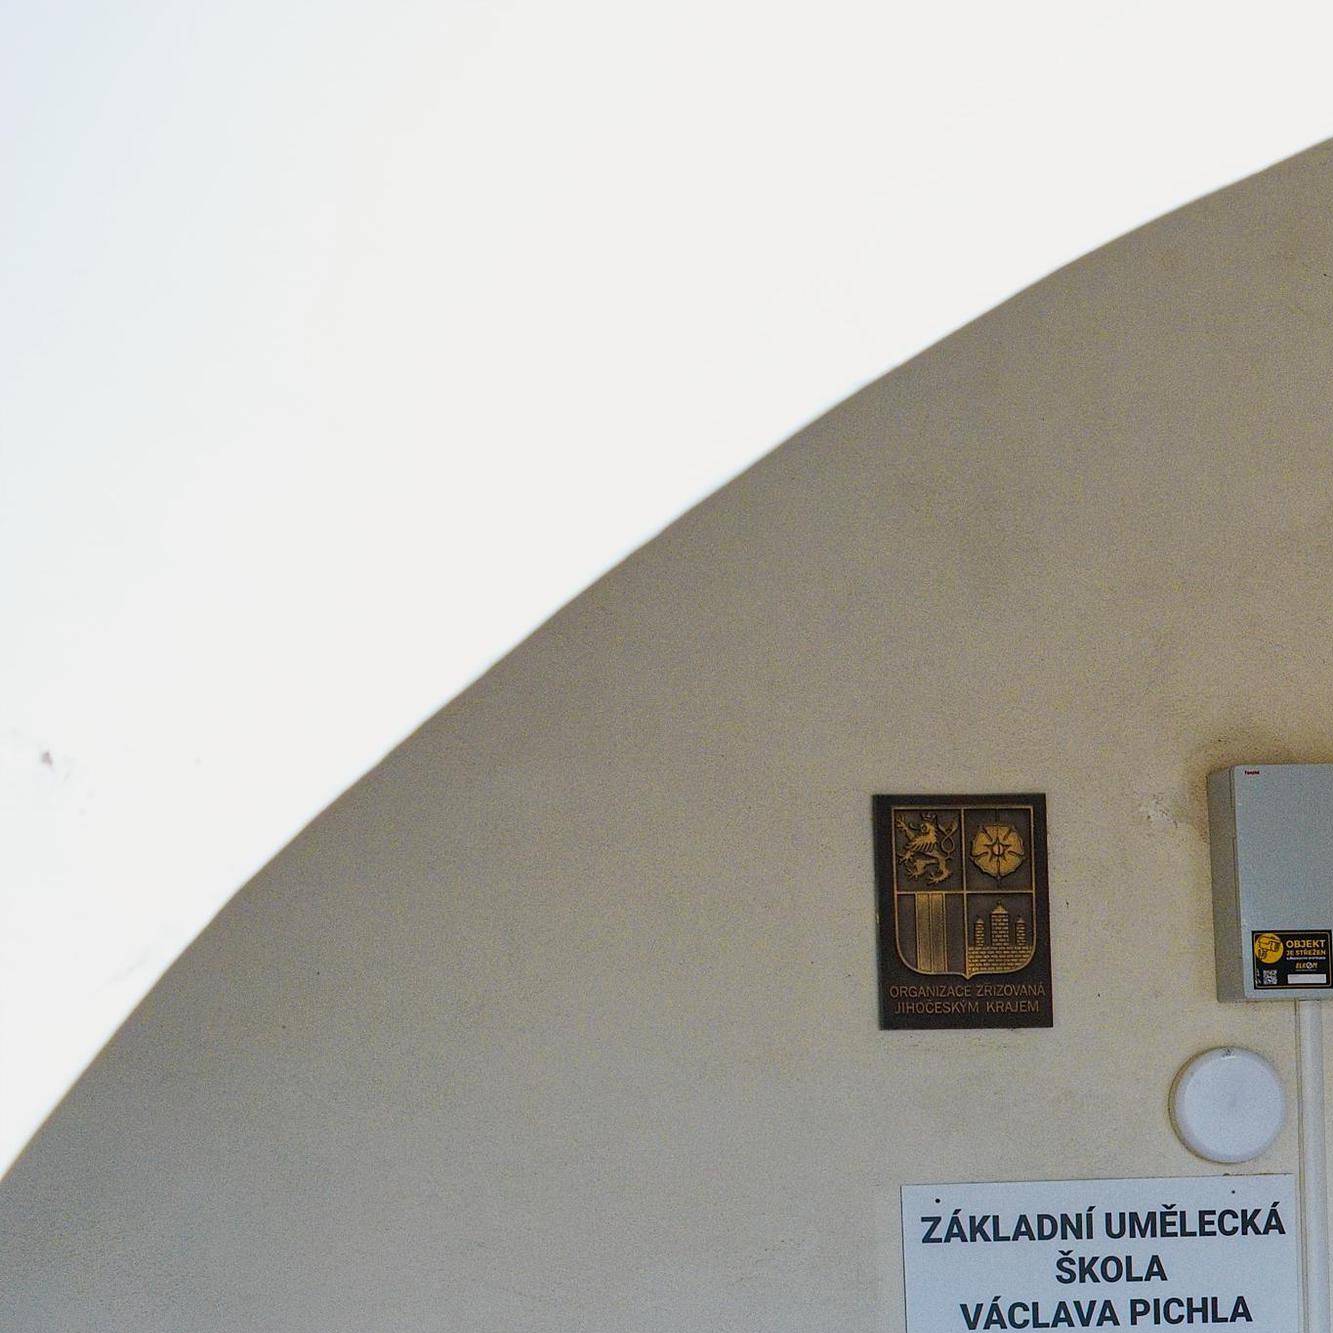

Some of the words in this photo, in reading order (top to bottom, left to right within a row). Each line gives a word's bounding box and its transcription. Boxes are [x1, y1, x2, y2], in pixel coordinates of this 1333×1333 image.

[1286, 940, 1326, 949] OBJEKT
[889, 985, 972, 998] ORGANIZACE
[976, 983, 1046, 997] ZŘIZOVANÁ
[895, 999, 979, 1014] JIHOČESKÝM
[986, 1000, 1040, 1013] KRAJEM
[920, 1206, 1097, 1244] ZÁKLADNÍ
[1104, 1202, 1287, 1238] UMĚLECKÁ
[1055, 1250, 1169, 1285] ŠKOLA
[959, 1296, 1121, 1331] VÁCLAVA
[1129, 1296, 1254, 1326] PICHLA
